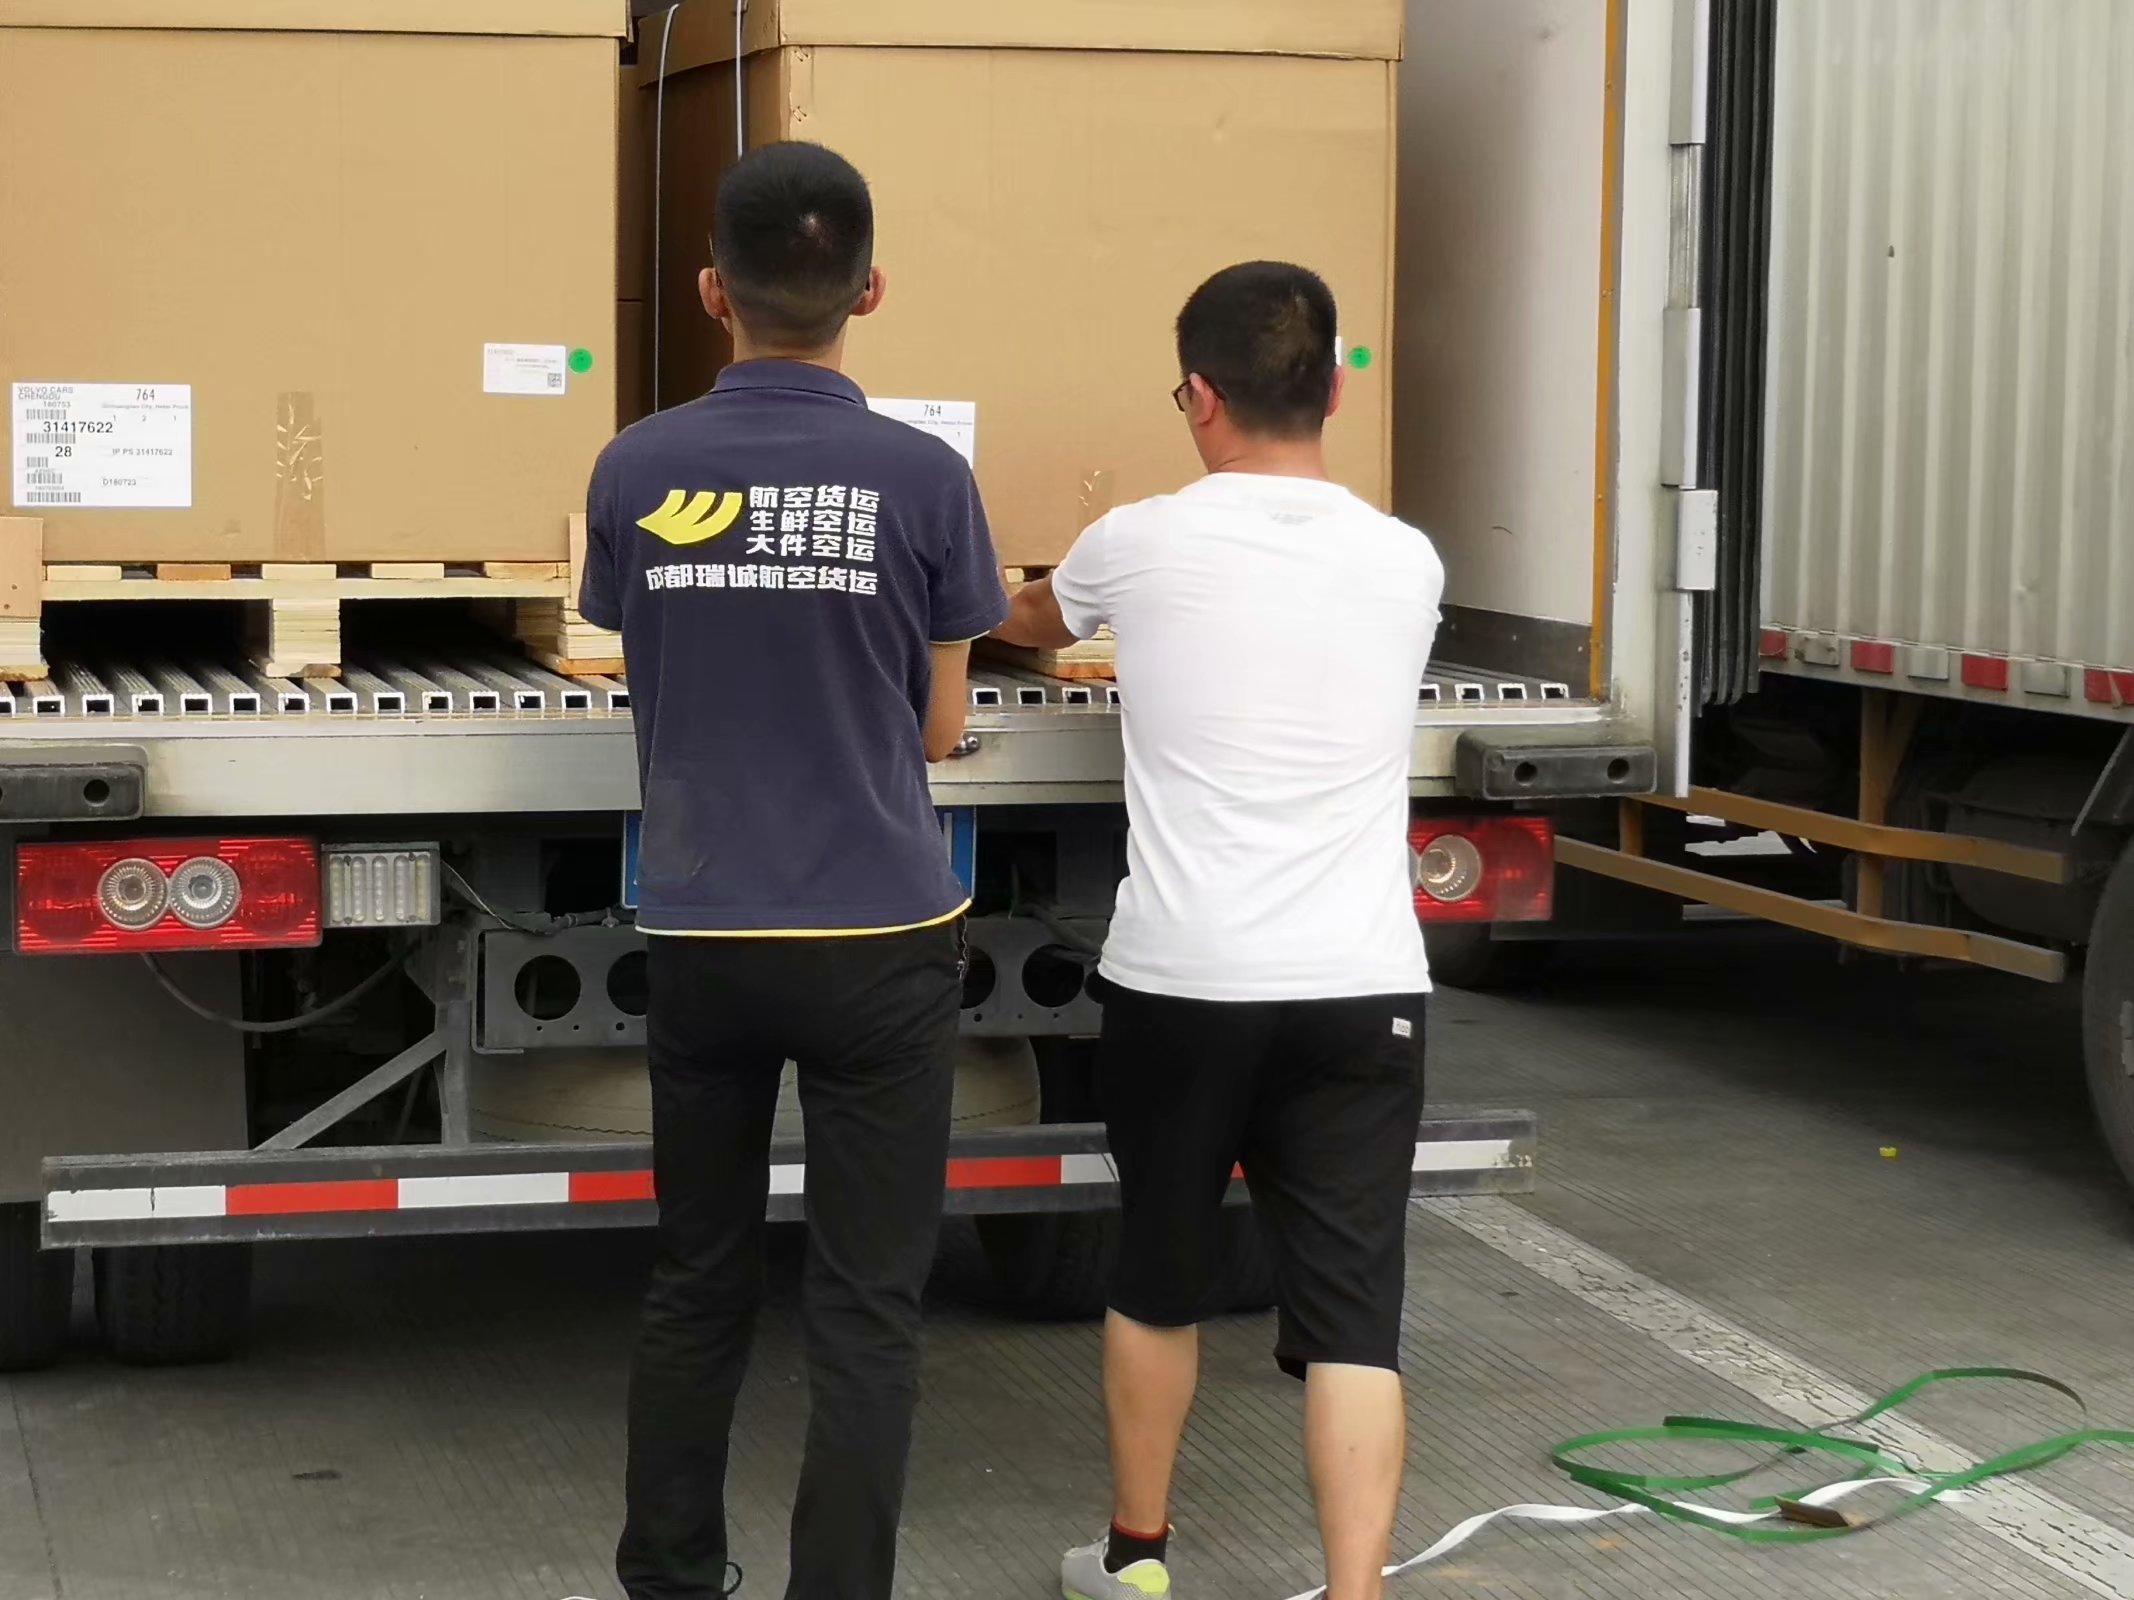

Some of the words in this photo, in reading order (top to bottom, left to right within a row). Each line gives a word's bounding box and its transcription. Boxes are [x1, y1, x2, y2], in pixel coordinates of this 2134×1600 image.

[18, 386, 48, 394] VOLVO
[136, 388, 155, 401] 764
[924, 404, 942, 417] 764
[43, 421, 114, 434] 31417622
[55, 446, 72, 457] 28
[750, 485, 880, 513] 航空货运
[750, 510, 877, 537] 生鲜空运
[746, 534, 876, 562] 大件空运
[646, 564, 878, 595] 成都瑞诚航空货运
